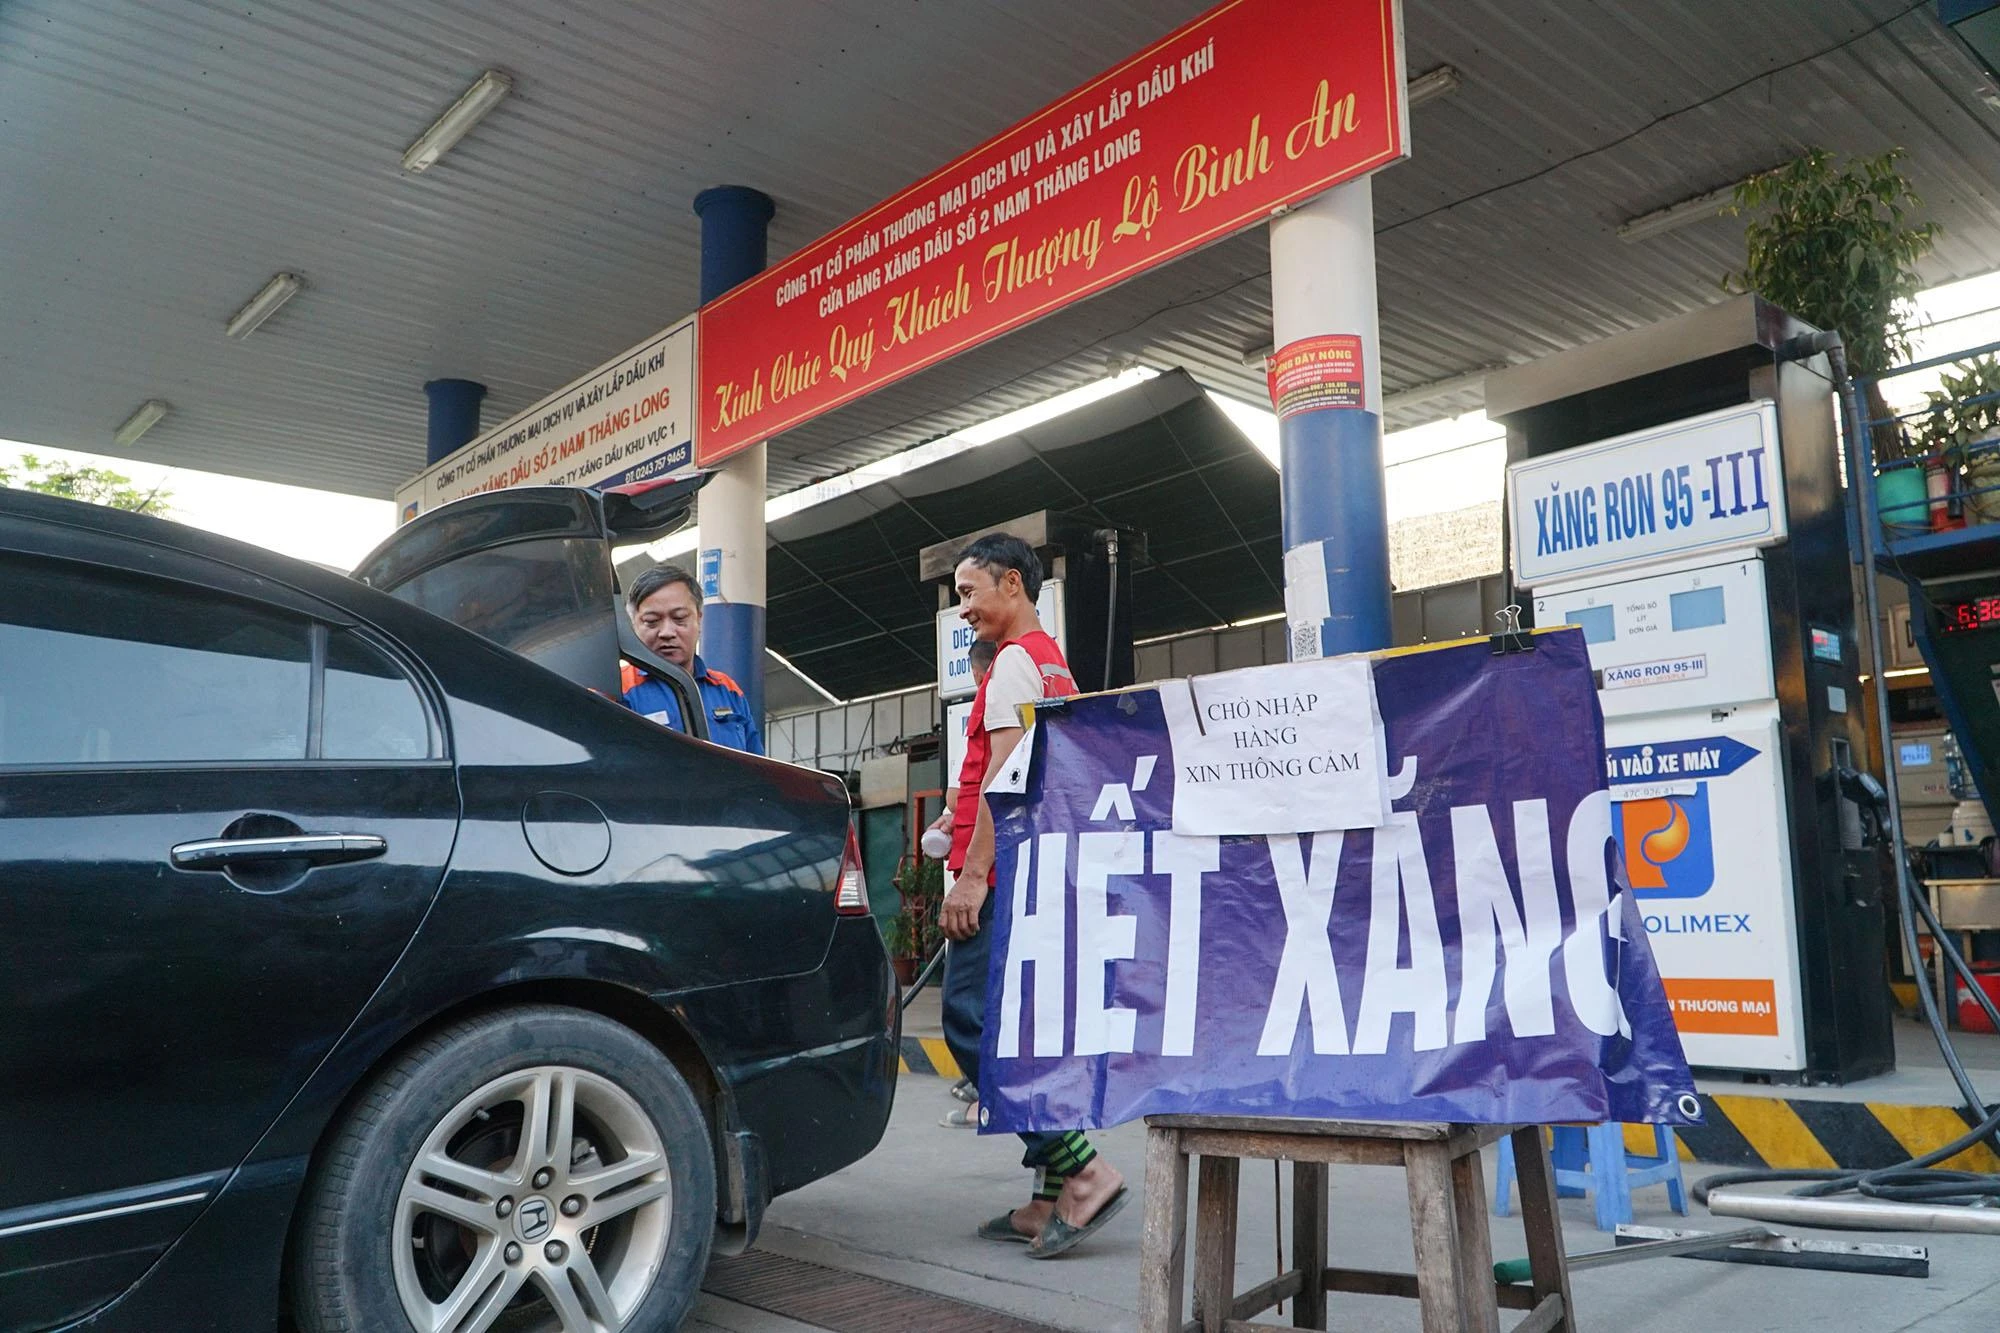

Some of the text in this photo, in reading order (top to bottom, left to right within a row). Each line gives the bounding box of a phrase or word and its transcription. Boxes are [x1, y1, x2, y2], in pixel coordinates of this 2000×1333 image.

[776, 36, 1215, 308] CÔNG TY CỔ PHẦN THƯƠNG MẠI DỊCH VỤ VÀ XÂY LẮP DẦU KHÍ
[819, 128, 1141, 318] CỬA HÀNG XĂNG DẦU SỐ 2 NAM THĂNG LONG
[711, 79, 1361, 433] Kính Chúc Quý Khách Thượng Lộ Bình An
[456, 462, 465, 479] TY
[543, 409, 560, 432] DỊCH
[562, 402, 574, 421] VỤ
[648, 348, 665, 374] KHÍ
[533, 441, 549, 473] SỐ
[551, 446, 557, 465] 2
[560, 431, 585, 461] NAM
[588, 408, 630, 445] THĂNG
[634, 388, 670, 423] LONG
[567, 468, 578, 483] TY
[625, 434, 645, 456] KHU
[670, 422, 676, 434] 1
[1534, 480, 1598, 557] XĂNG
[1604, 471, 1656, 543] RON
[1741, 565, 1747, 576] 1
[1538, 601, 1546, 612] 2
[953, 627, 975, 649] DIEZ
[949, 657, 971, 677] 0,001
[1608, 668, 1641, 682] XĂNG
[1645, 664, 1670, 677] RON
[1674, 660, 1703, 673] 95-III
[1208, 693, 1318, 721] CHỜ NHẬP
[1234, 725, 1297, 749] HÀNG
[1186, 765, 1222, 783] XIN
[1227, 757, 1302, 781] THÔNG
[1657, 754, 1680, 774] XE
[1683, 747, 1721, 772] MÁY
[997, 755, 1221, 1060] HẾT
[1644, 914, 1752, 933] OLIMEX
[1678, 998, 1738, 1013] THƯƠNG
[1742, 1001, 1771, 1017] MẠI
